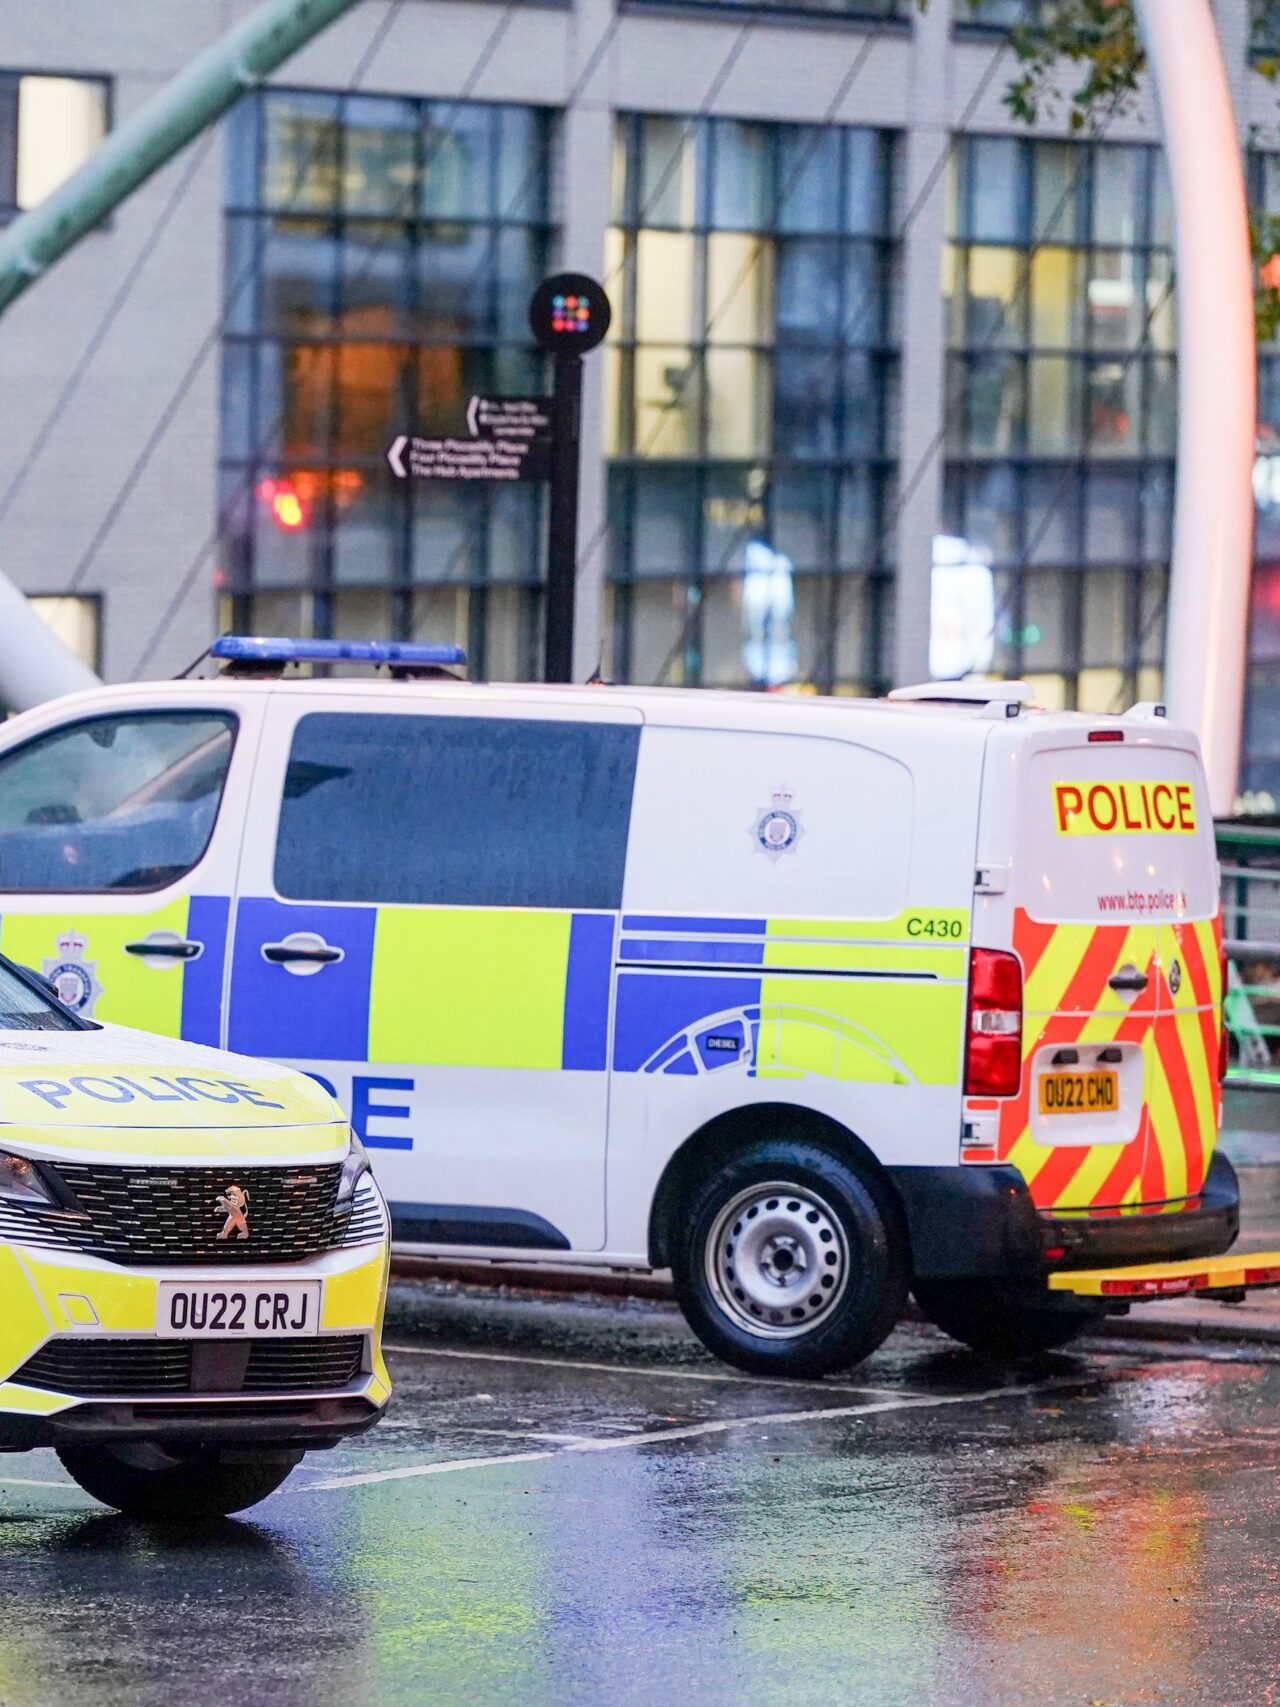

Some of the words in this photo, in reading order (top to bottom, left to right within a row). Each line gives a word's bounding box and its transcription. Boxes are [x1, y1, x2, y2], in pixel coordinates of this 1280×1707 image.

[1055, 784, 1195, 832] POLICE
[907, 918, 962, 937] C430
[708, 1038, 737, 1050] DIESEL
[16, 1075, 286, 1110] POLICE
[1045, 1077, 1084, 1107] OU22
[300, 1071, 415, 1151] E
[170, 1292, 247, 1330] OU22
[254, 1293, 308, 1330] CRJ
